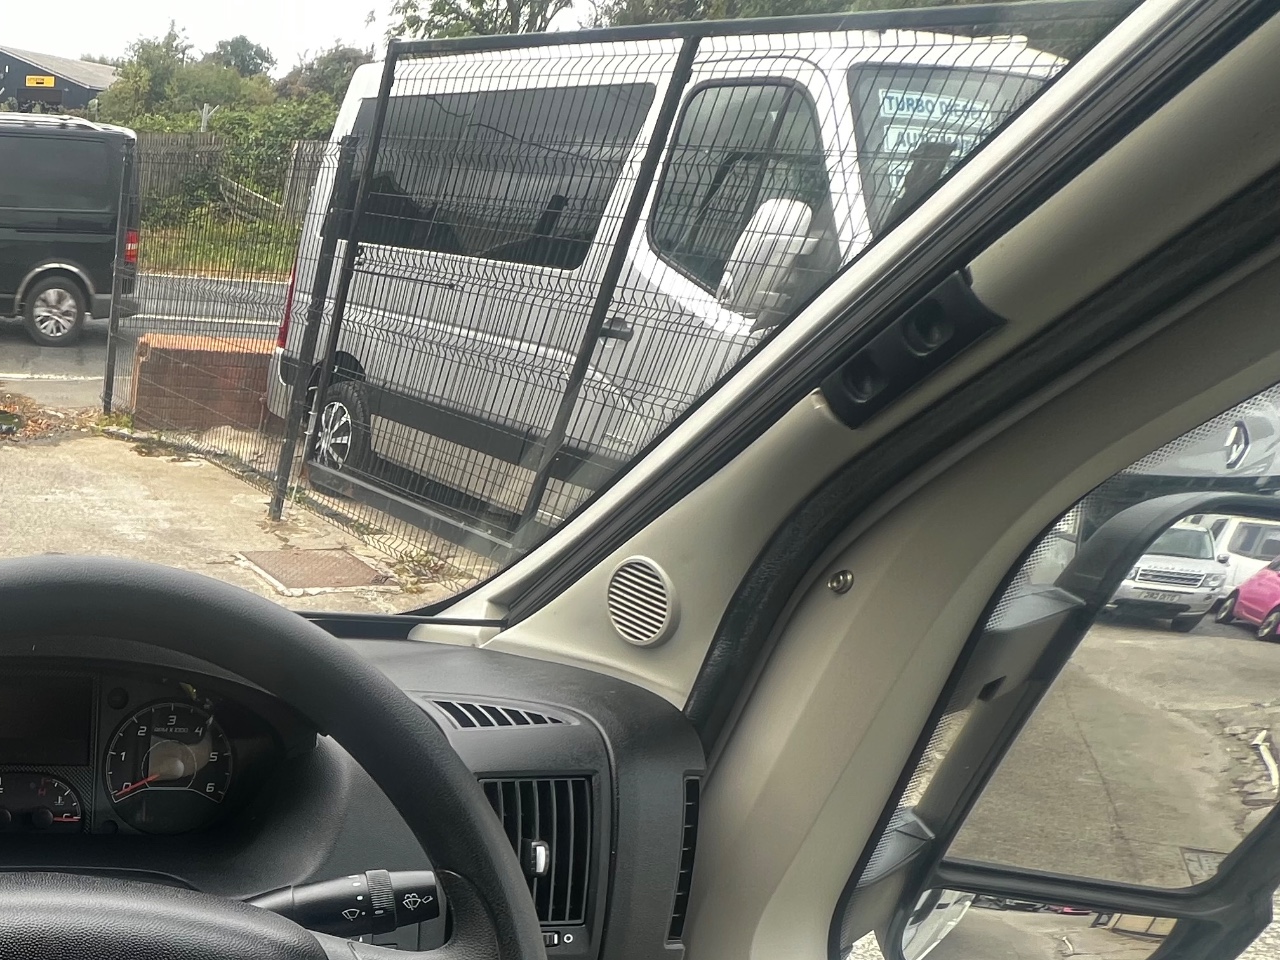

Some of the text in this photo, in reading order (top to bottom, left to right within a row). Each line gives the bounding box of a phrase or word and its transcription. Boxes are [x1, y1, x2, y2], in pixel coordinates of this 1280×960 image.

[885, 95, 934, 113] TURBO
[167, 715, 177, 725] 3
[137, 726, 147, 736] 2
[195, 727, 204, 737] 4
[120, 752, 126, 761] 1
[209, 752, 218, 761] 5
[206, 783, 215, 792] 6
